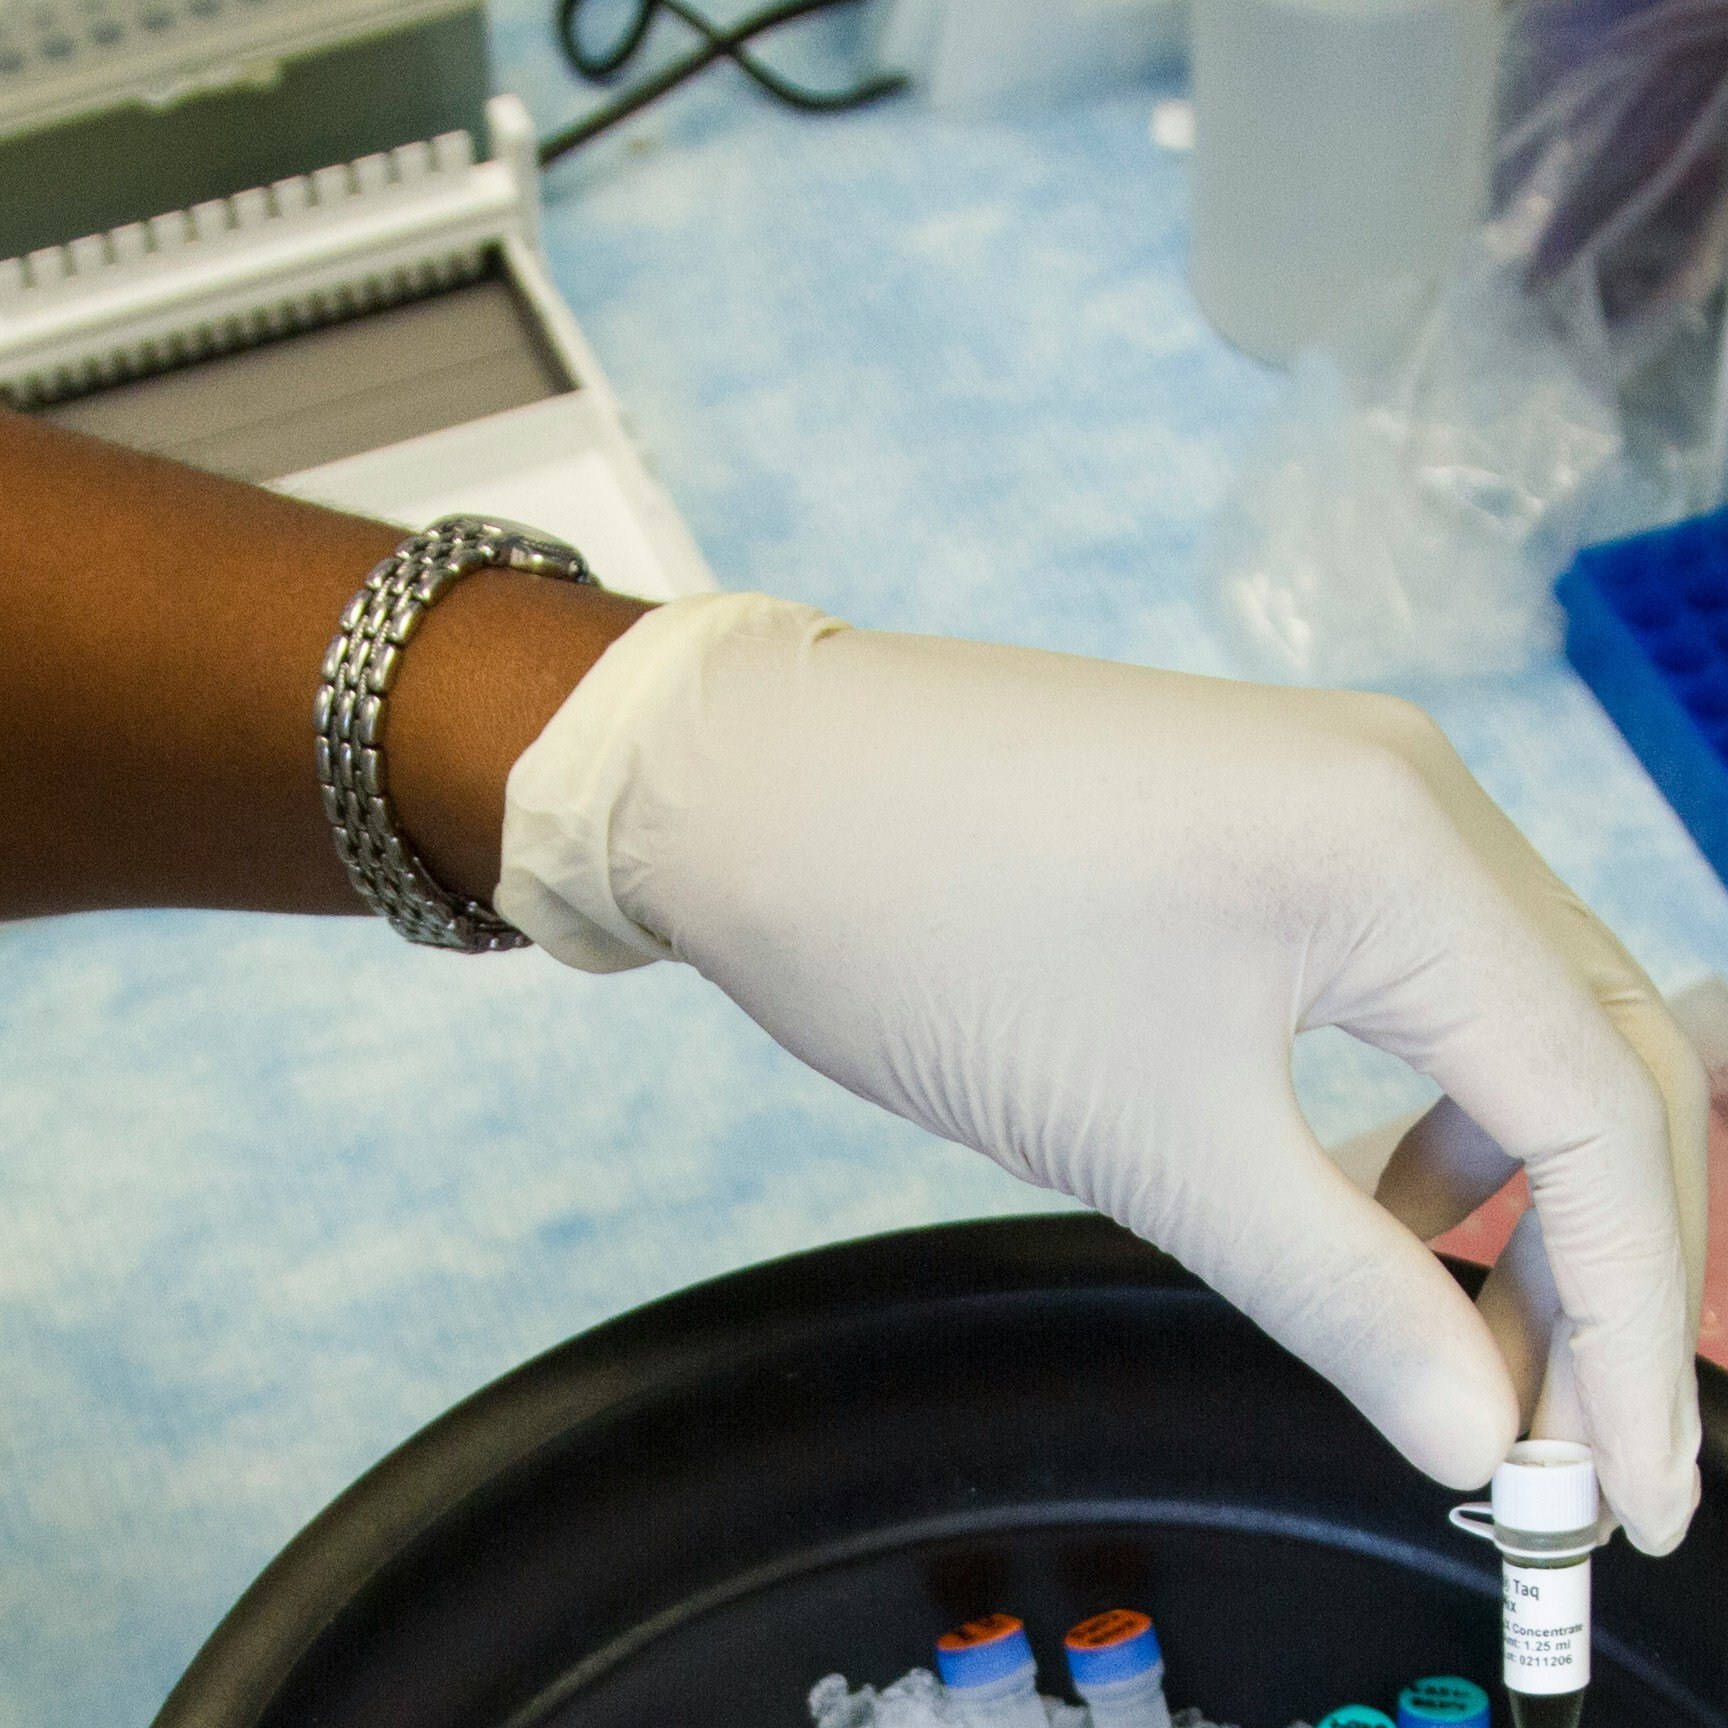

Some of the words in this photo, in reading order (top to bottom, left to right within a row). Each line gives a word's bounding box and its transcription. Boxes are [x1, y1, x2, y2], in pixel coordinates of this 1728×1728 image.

[1513, 1579, 1540, 1601] Taq
[1512, 1622, 1584, 1637] Concentrate
[1523, 1641, 1551, 1652] 1.25
[1518, 1654, 1573, 1667] 0211206
